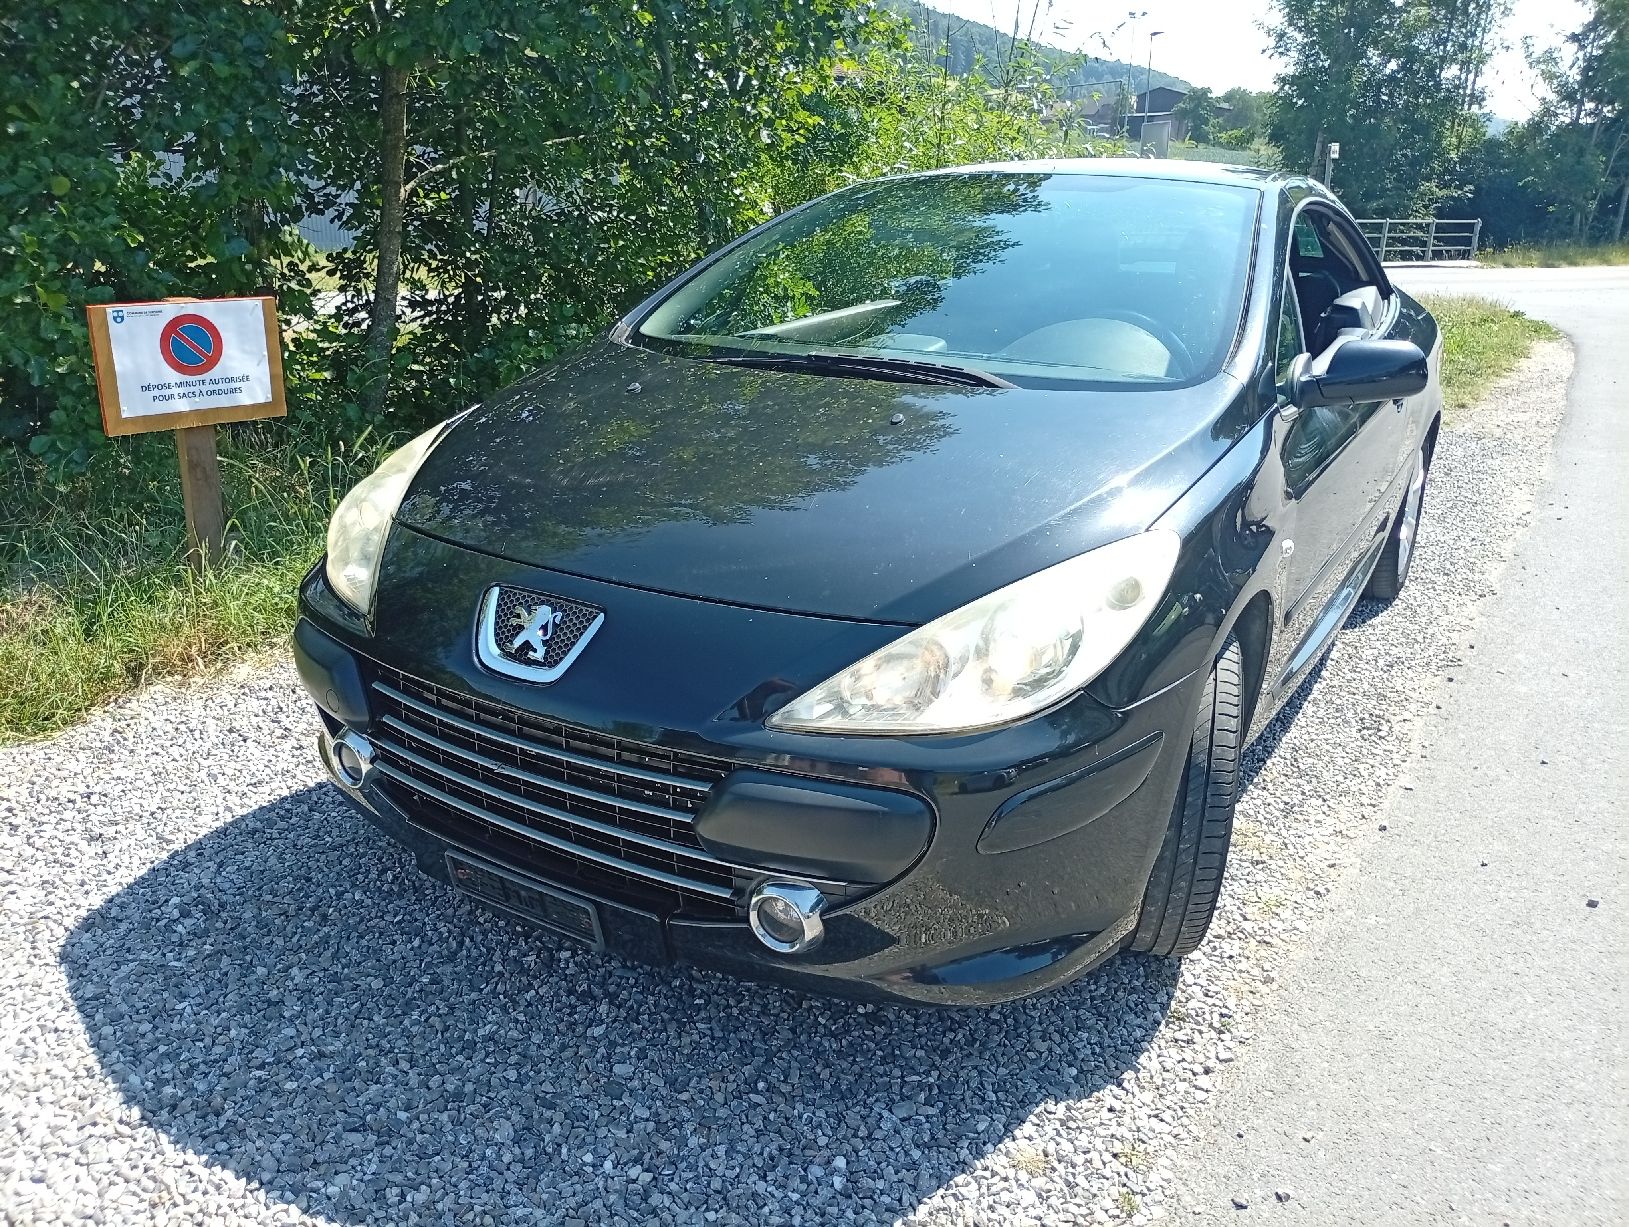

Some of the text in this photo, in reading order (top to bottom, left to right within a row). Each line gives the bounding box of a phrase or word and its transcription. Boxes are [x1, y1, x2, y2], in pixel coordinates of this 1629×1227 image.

[141, 374, 250, 392] DÉPOSE-MINUTE AUTORISÉE
[152, 387, 243, 402] POUR SACS À ORDURES
